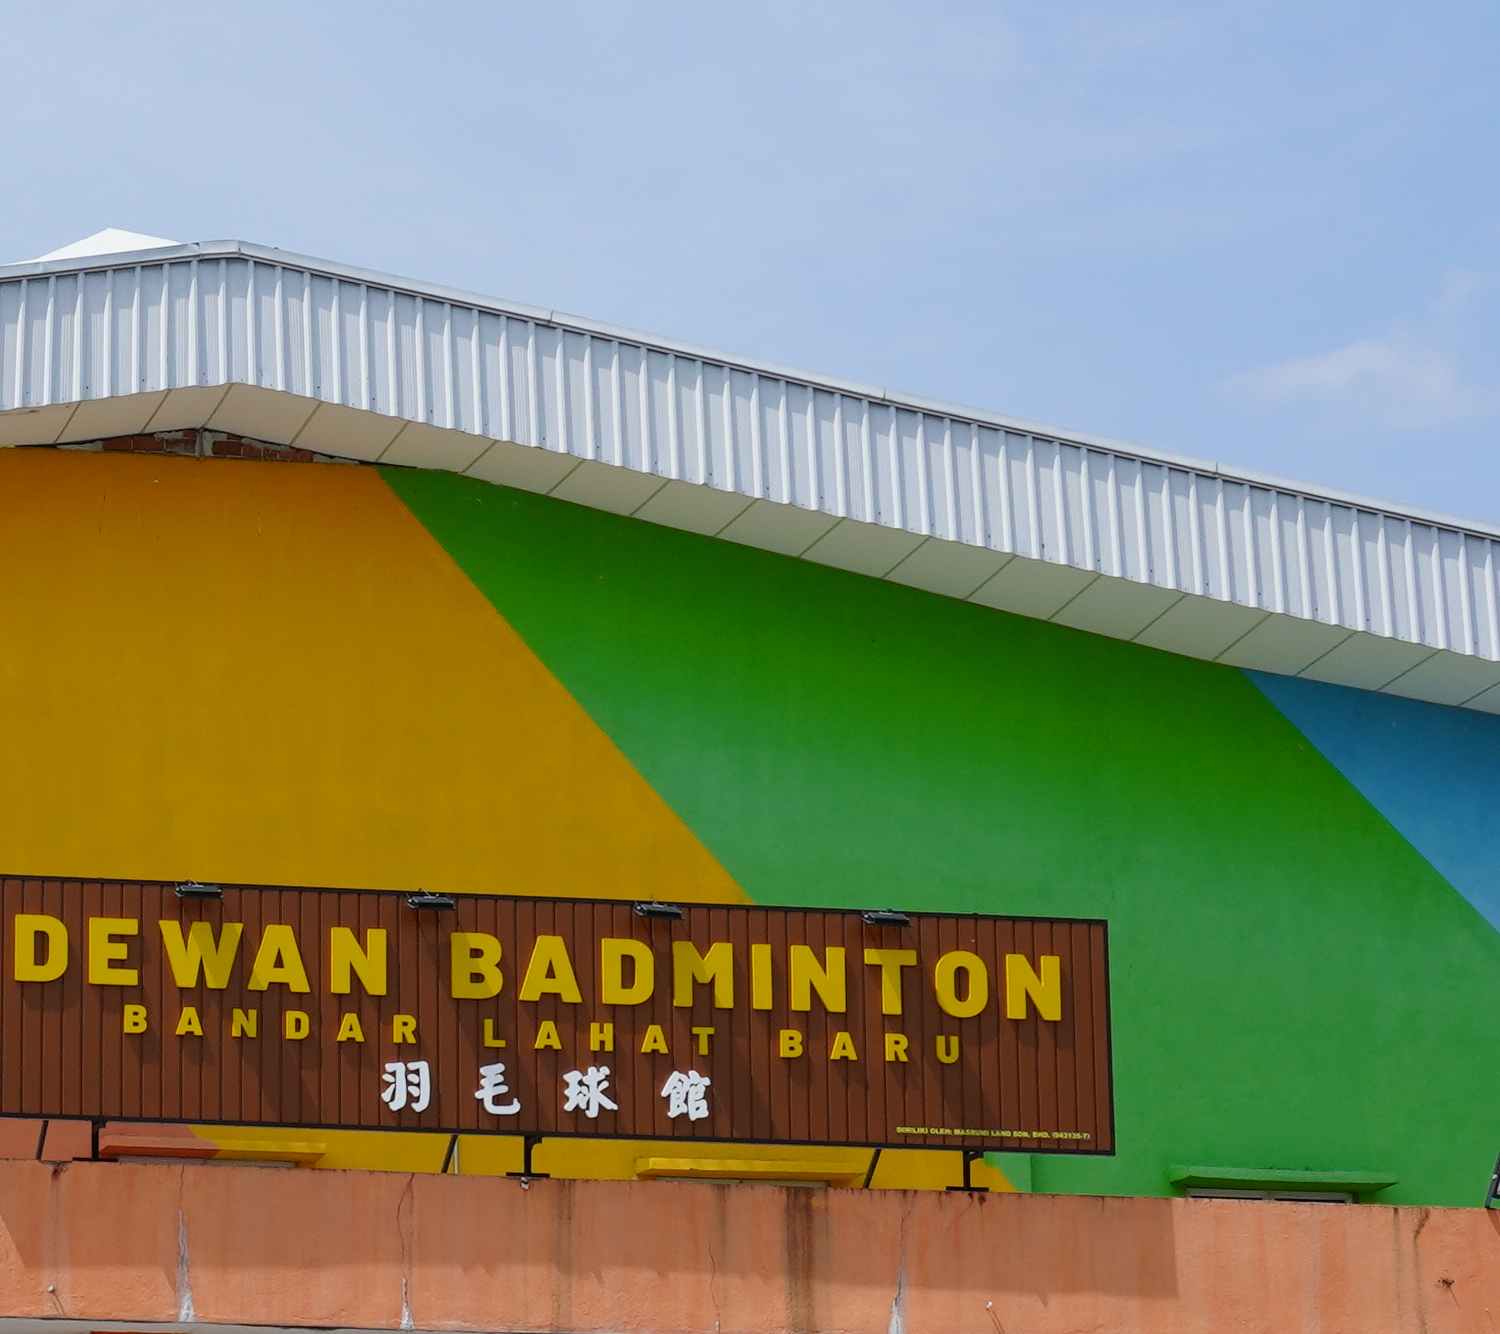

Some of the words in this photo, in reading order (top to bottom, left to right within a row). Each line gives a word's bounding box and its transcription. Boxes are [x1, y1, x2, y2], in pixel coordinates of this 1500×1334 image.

[14, 913, 389, 997] DEWAN
[450, 931, 1062, 1023] BADMINTON
[123, 1003, 418, 1045] BANDAR
[483, 1018, 715, 1057] LAHAT
[779, 1028, 960, 1065] BARU
[379, 1060, 711, 1122] 羽毛球館
